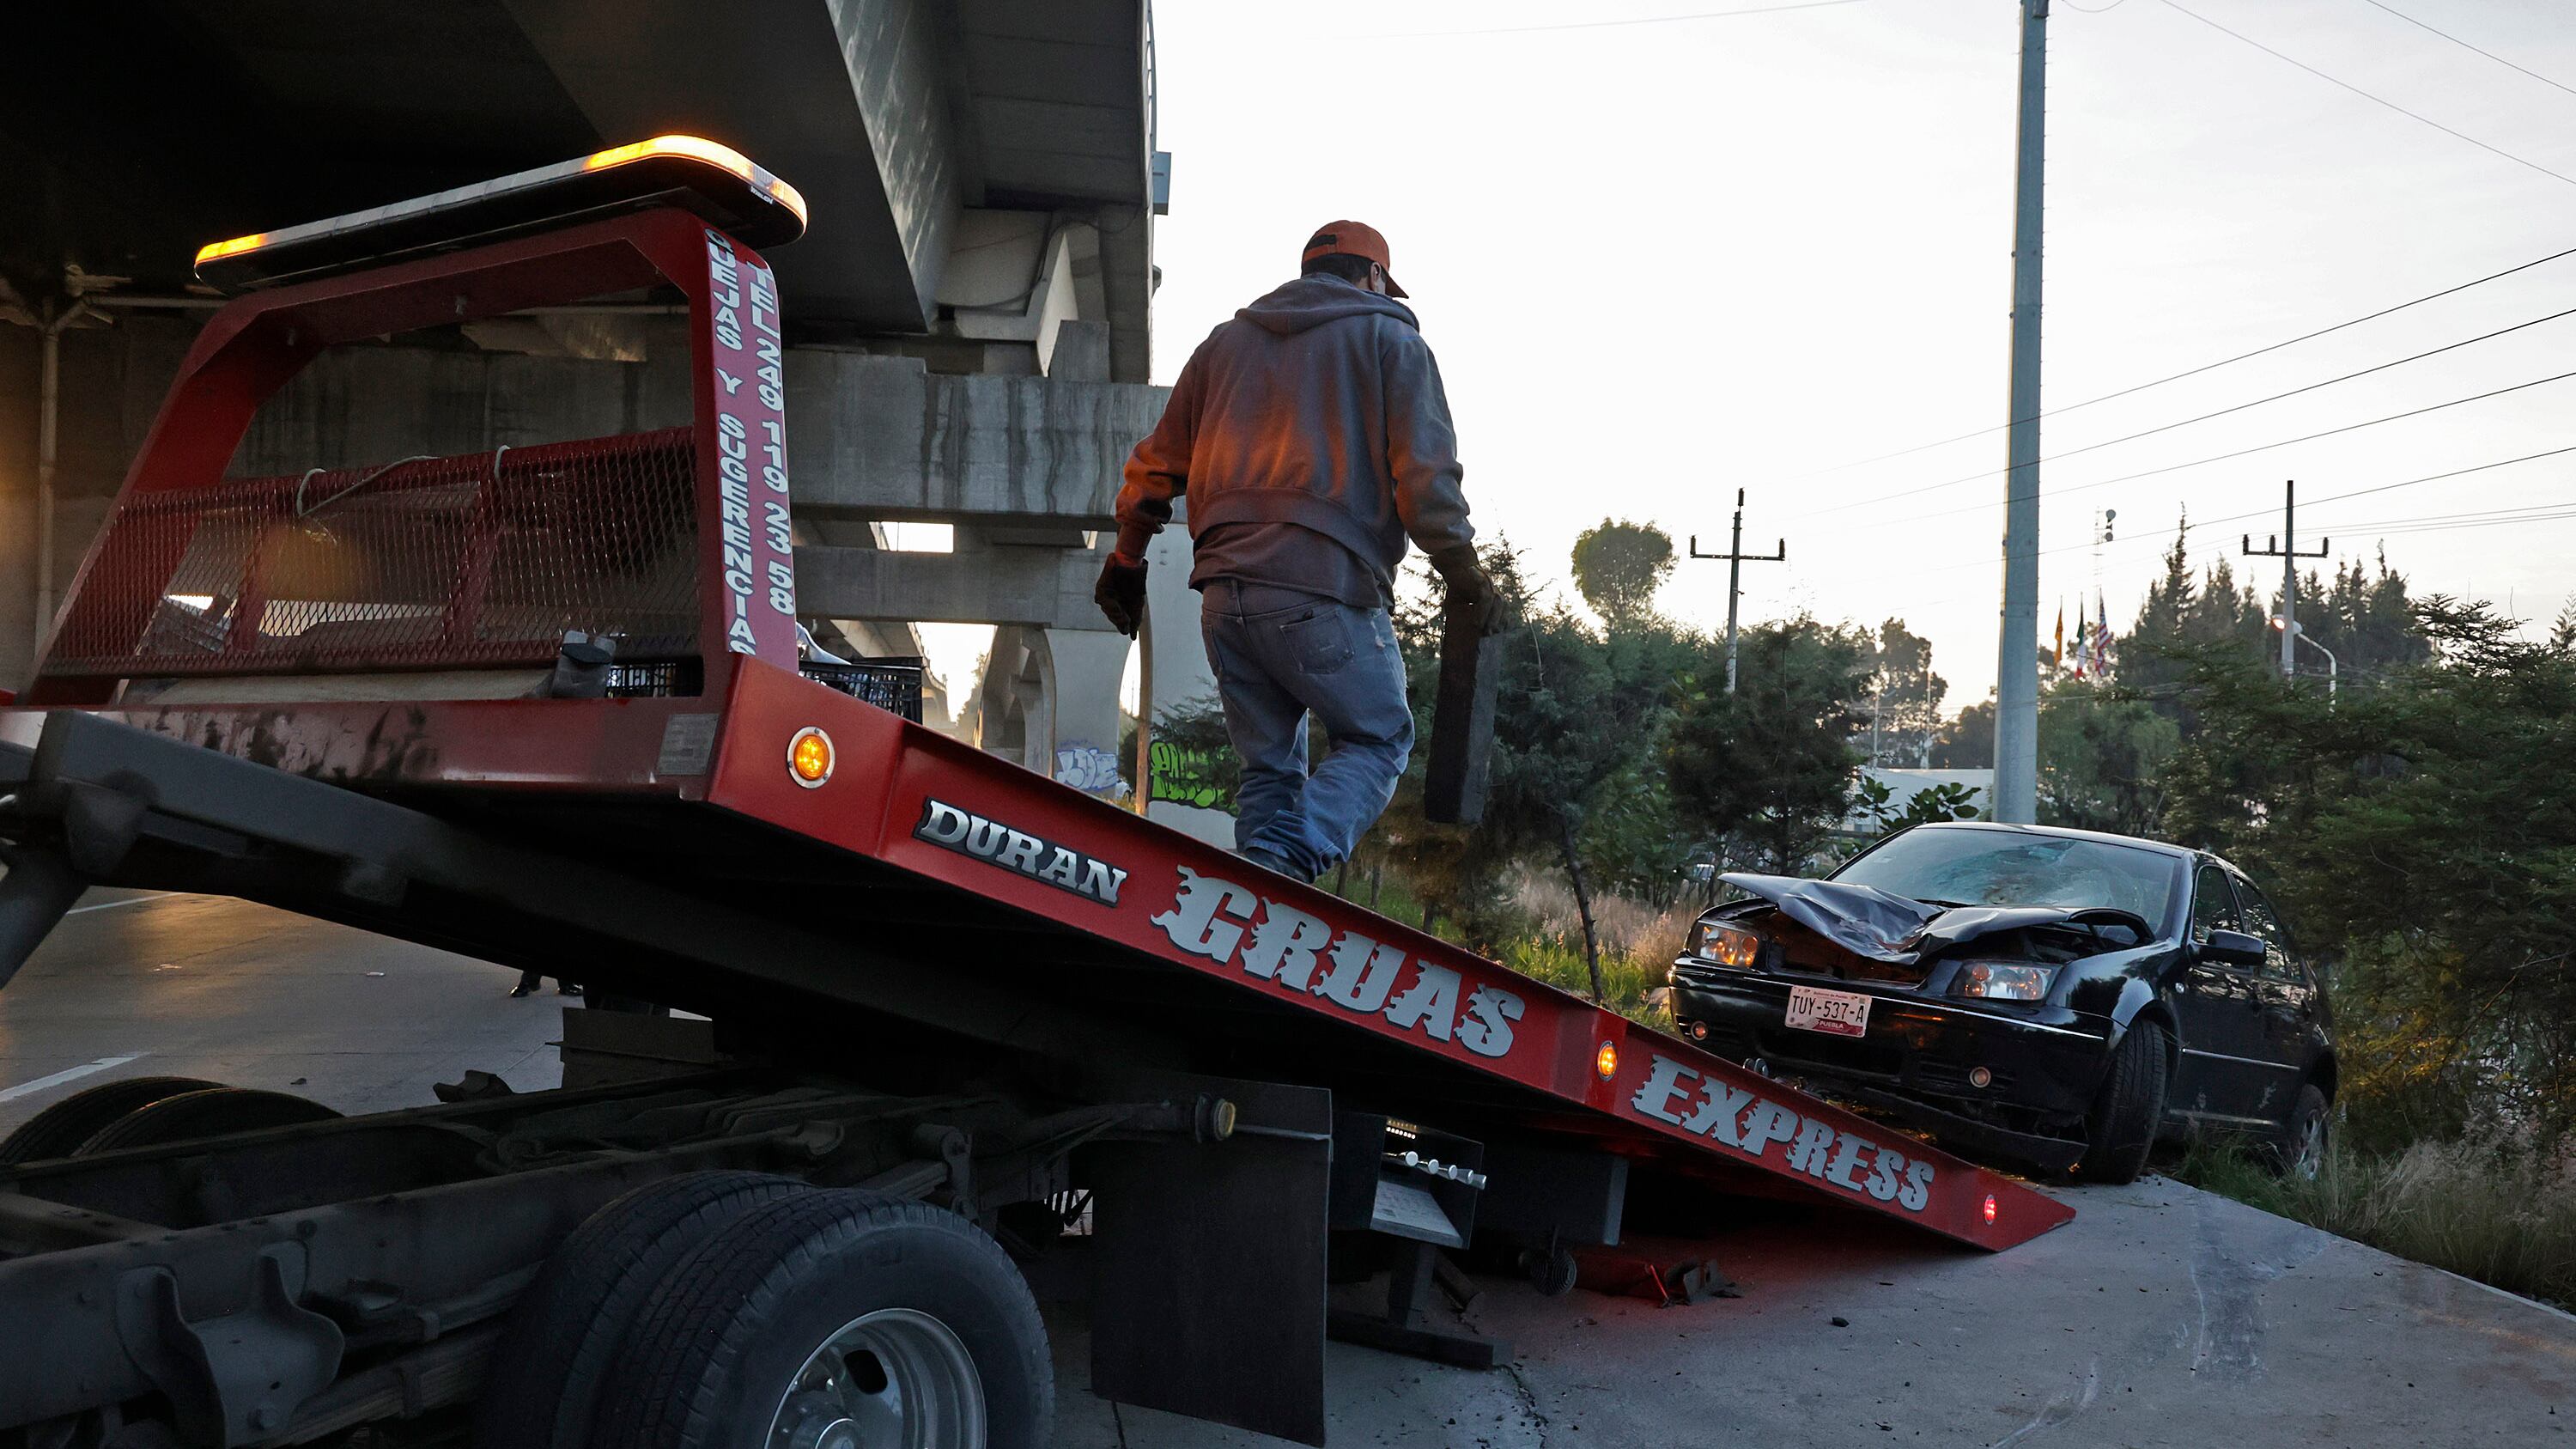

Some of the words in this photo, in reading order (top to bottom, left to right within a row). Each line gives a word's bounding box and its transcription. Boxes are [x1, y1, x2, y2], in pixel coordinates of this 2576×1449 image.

[705, 228, 743, 350] QUEJAS
[716, 367, 744, 396] Y
[762, 420, 789, 494] 119
[763, 501, 791, 555] 23
[768, 560, 795, 616] 58
[920, 798, 1128, 905] DURAN
[1150, 864, 1526, 1059] GRUAS
[1793, 995, 1864, 1022] TUY-537-A
[1818, 1020, 1844, 1030] PUEBLA
[1631, 1053, 1935, 1213] EXPRESS
